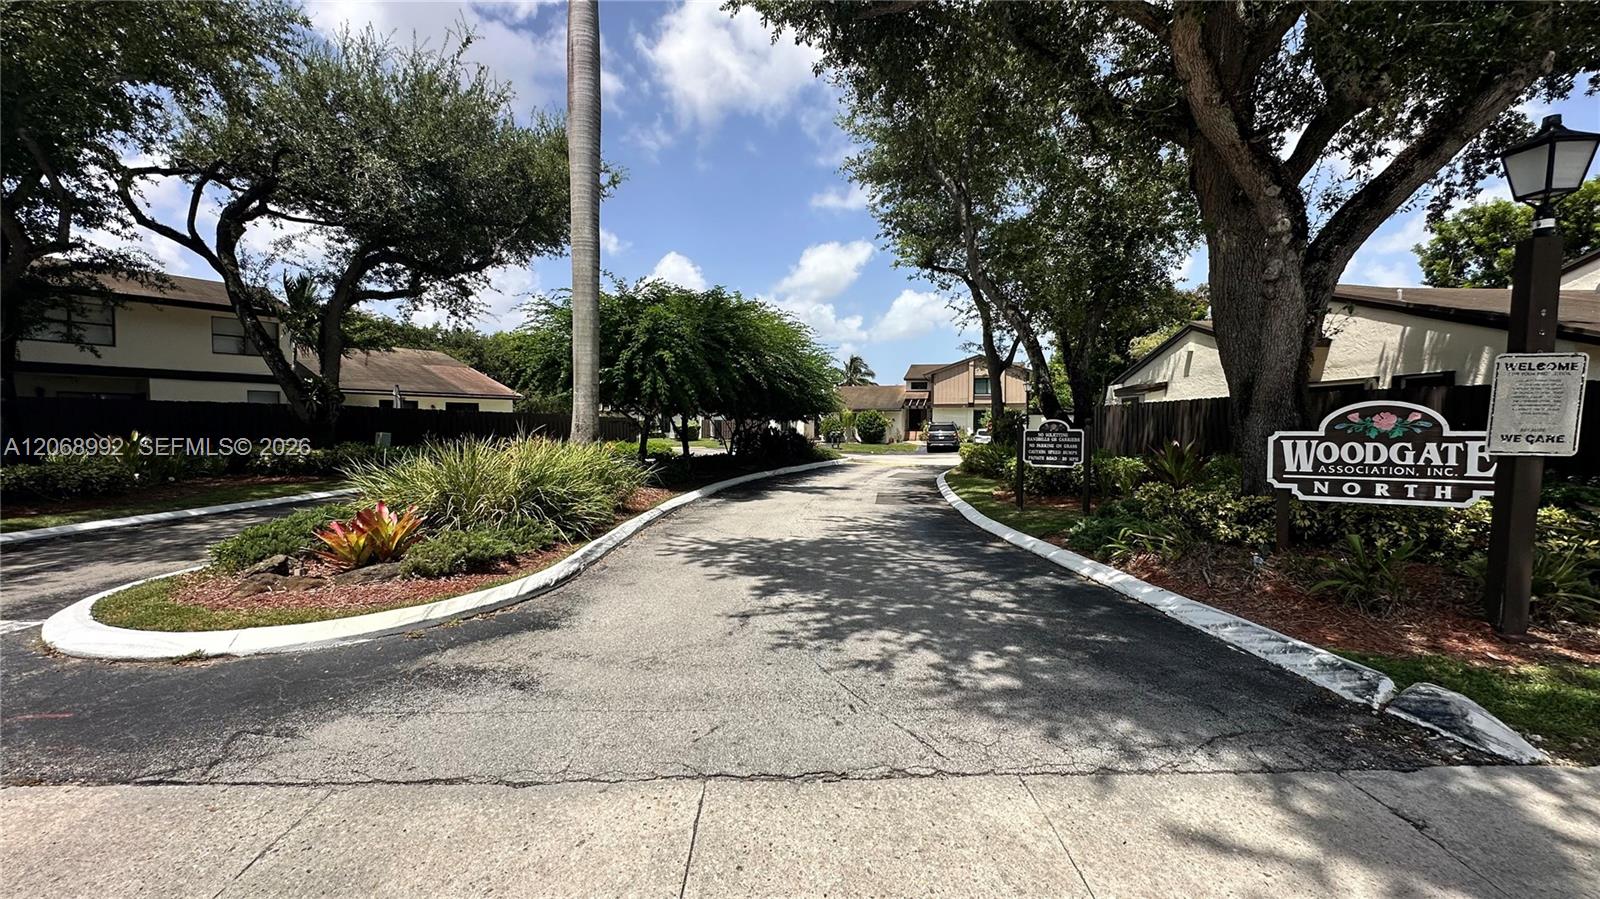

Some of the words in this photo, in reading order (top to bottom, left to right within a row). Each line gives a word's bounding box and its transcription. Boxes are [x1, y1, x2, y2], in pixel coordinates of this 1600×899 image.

[1504, 362, 1580, 371] WELCOME
[1500, 434, 1522, 443] WE
[1525, 434, 1565, 443] CARE
[1280, 440, 1498, 477] WOODGATE
[1318, 465, 1419, 477] ASSOCIATION,
[1427, 467, 1458, 477] INC.
[1313, 481, 1452, 500] NORTH
